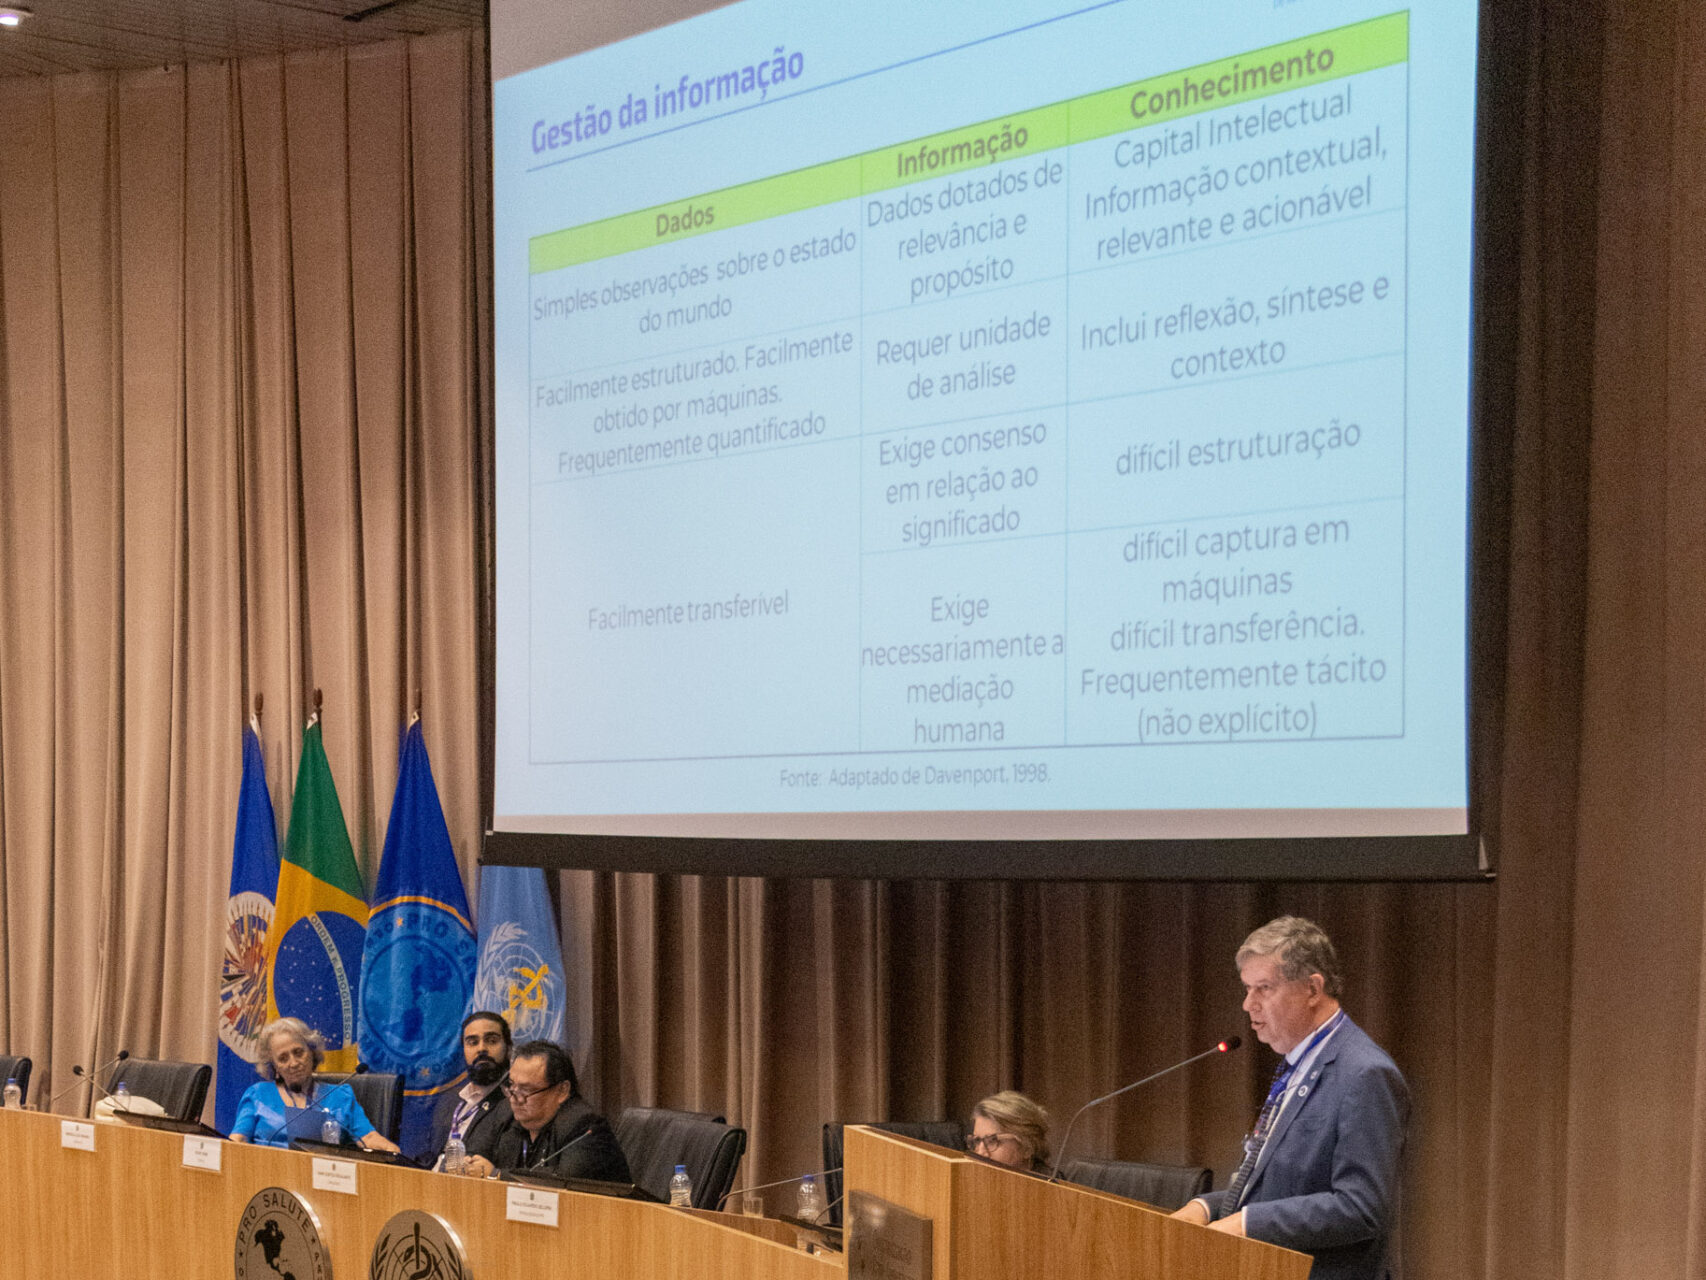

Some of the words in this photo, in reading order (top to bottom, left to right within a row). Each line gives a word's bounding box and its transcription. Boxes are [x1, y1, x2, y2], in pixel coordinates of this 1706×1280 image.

[532, 104, 611, 154] Gestão
[619, 94, 648, 131] da
[655, 46, 804, 105] informação
[1130, 45, 1334, 120] Conhecimento
[897, 125, 1028, 178] Informação
[1114, 124, 1201, 171] Capital
[1209, 83, 1352, 148] Intelectual
[867, 190, 933, 228] Dados
[939, 166, 1028, 209] dotados
[1034, 159, 1063, 187] de
[1086, 164, 1229, 219] Informação
[1235, 126, 1386, 189] contextual,
[656, 204, 714, 238] Dados
[898, 214, 1008, 260] relevância
[1013, 211, 1027, 235] e
[1098, 211, 1212, 260] relevante
[1220, 211, 1235, 236] e
[1242, 177, 1372, 230] acionável
[533, 287, 598, 321] Simples
[601, 263, 708, 306] observações
[717, 250, 767, 282] sobre
[773, 250, 785, 268] o
[790, 228, 856, 264] estado
[910, 254, 1013, 304] propósito
[639, 308, 662, 334] do
[667, 295, 732, 328] mundo
[1082, 314, 1147, 351] Inclui
[1155, 297, 1260, 339] reflexão,
[1267, 277, 1364, 319] síntese
[1372, 273, 1389, 301] e
[877, 327, 953, 365] Requer
[958, 311, 1051, 350] unidade
[1171, 339, 1285, 380] contexto
[536, 373, 628, 409] Facilmente
[631, 350, 740, 391] estruturado.
[745, 329, 853, 370] Facilmente
[908, 373, 933, 401] de
[939, 361, 1016, 396] análise
[594, 404, 649, 435] obtido
[654, 402, 681, 429] por
[687, 385, 783, 420] máquinas.
[558, 434, 702, 474] Frequentemente
[707, 412, 826, 455] quantificado
[879, 437, 935, 470] Exige
[941, 419, 1046, 455] consenso
[1116, 440, 1180, 477] difícil
[1188, 418, 1361, 468] estruturação
[886, 480, 920, 504] em
[926, 465, 1005, 503] relação
[1011, 463, 1038, 489] ao
[902, 505, 1020, 545] significado
[1123, 529, 1188, 562] difícil
[1195, 520, 1297, 558] captura
[1305, 516, 1349, 543] em
[931, 592, 989, 625] Exige
[1162, 568, 1293, 607] máquinas
[588, 601, 684, 631] Facilmente
[1111, 620, 1174, 652] difícil
[1182, 607, 1365, 648] transferência.
[862, 632, 1046, 667] necessariamente
[1051, 631, 1064, 655] a
[907, 674, 1014, 709] mediação
[1081, 660, 1298, 700] Frequentemente
[1306, 653, 1386, 685] tácito
[914, 718, 1004, 744] humana
[1138, 706, 1192, 744] (não
[1198, 702, 1317, 742] explícito)
[829, 767, 898, 791] Adaptado
[902, 767, 919, 785] de
[310, 915, 335, 953] ORDEM
[335, 966, 352, 1040] PROGRESSO
[239, 1206, 257, 1244] PRO
[262, 1192, 312, 1234] SALUTE
